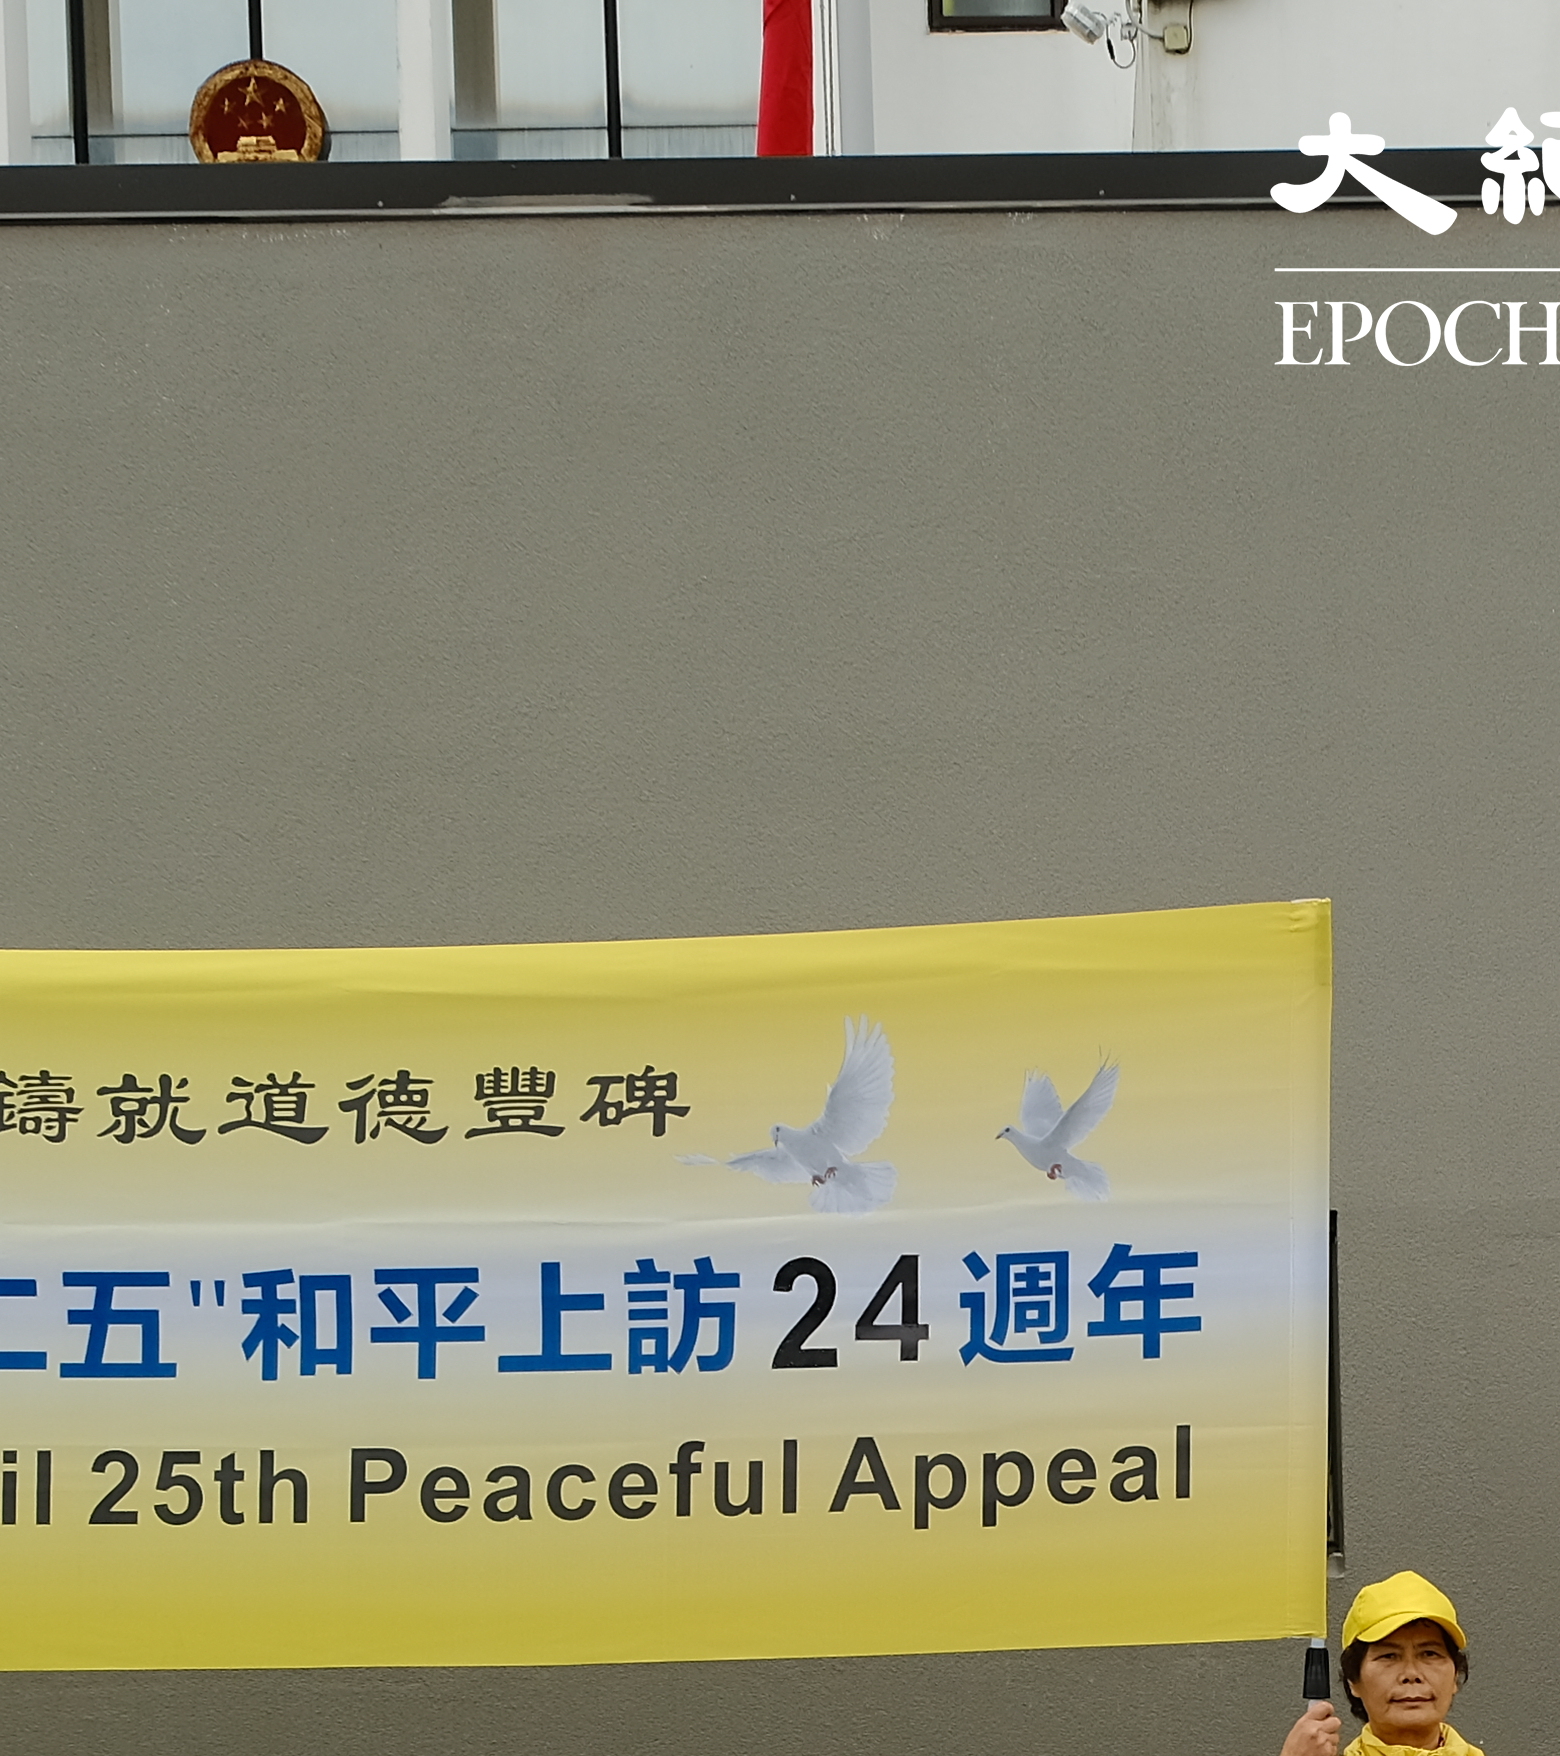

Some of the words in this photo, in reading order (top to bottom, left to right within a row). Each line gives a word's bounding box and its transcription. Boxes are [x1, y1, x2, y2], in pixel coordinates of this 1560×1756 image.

[89, 1450, 307, 1525] 25th
[350, 1440, 797, 1522] Peaceful
[829, 1425, 1190, 1529] Appeal
